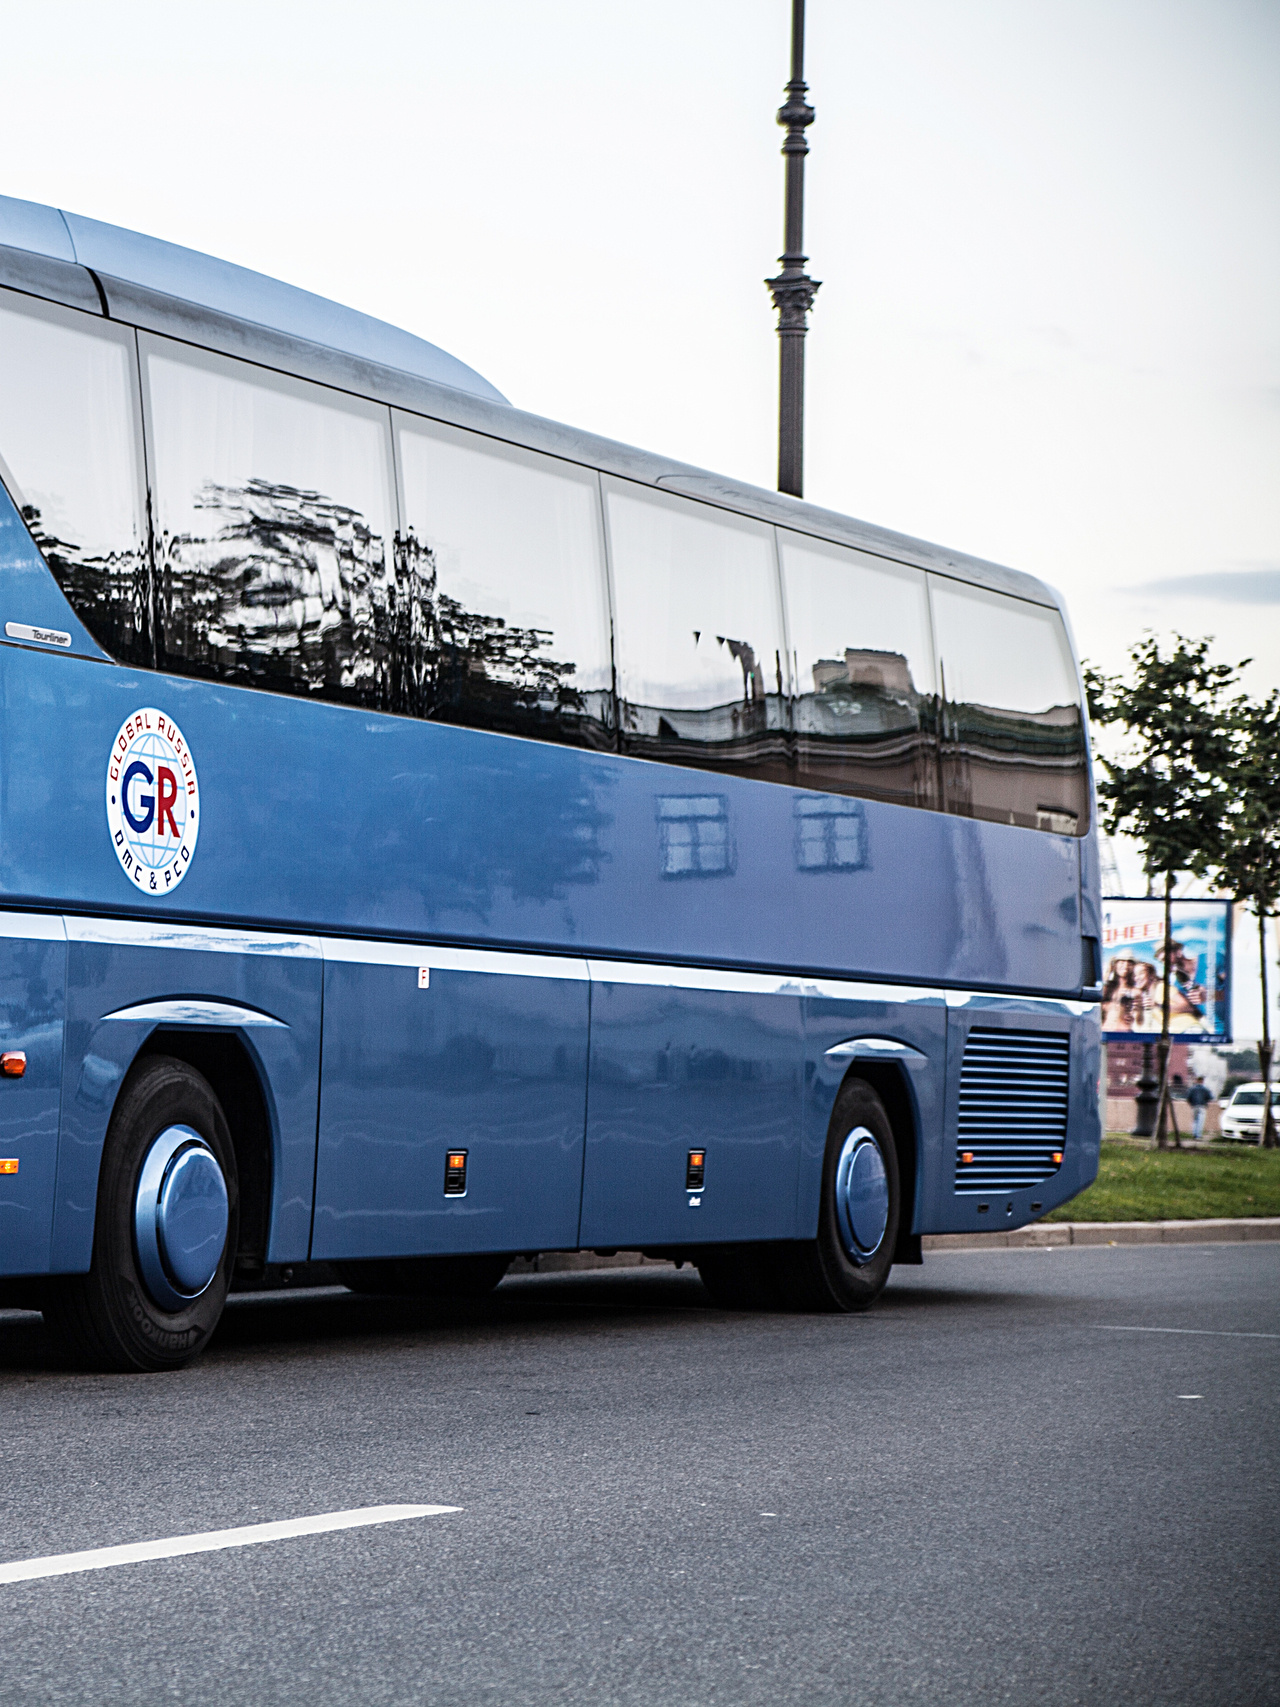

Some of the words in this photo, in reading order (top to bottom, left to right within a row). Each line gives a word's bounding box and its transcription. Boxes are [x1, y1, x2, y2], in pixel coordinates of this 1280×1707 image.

[32, 629, 68, 644] Tourliner
[110, 712, 152, 782] GLOBAL
[157, 715, 196, 796] RUSSIA
[122, 760, 181, 839] GR
